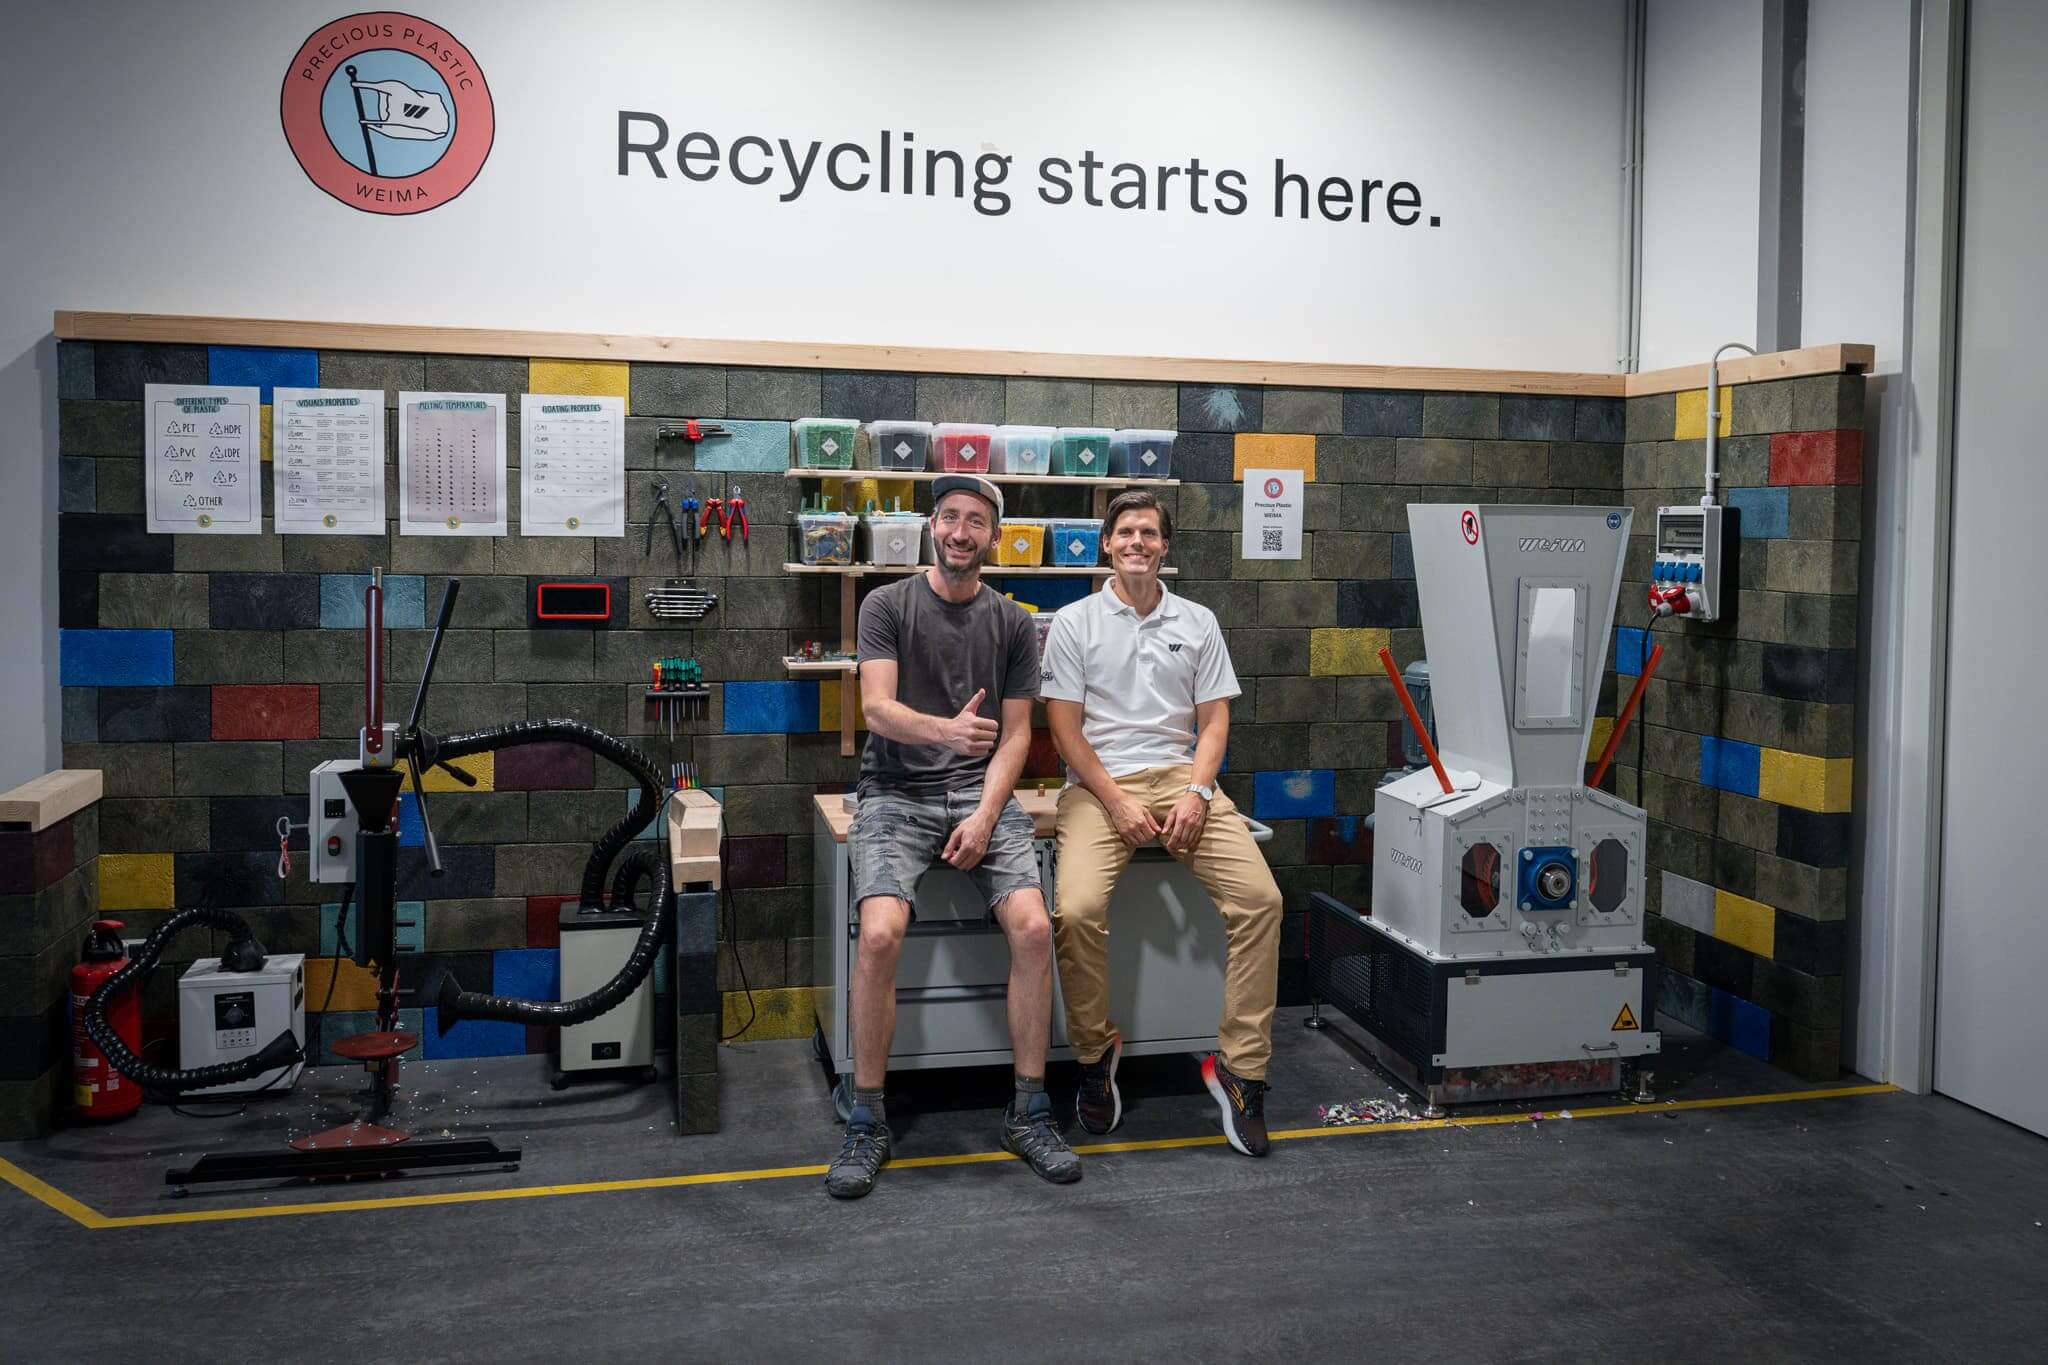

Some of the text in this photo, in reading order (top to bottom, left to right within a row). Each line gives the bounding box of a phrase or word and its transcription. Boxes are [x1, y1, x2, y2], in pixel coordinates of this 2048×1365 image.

[302, 24, 473, 90] PRECIOUS PLASTIC
[619, 111, 1441, 228] Recycling starts here.
[356, 182, 429, 202] WEIMA
[182, 424, 196, 433] PET
[224, 425, 241, 434] HDPE
[180, 447, 197, 457] PVC
[224, 448, 241, 458] LDPE
[184, 472, 194, 481] PP
[228, 473, 238, 483] PS
[198, 496, 223, 506] OTHER
